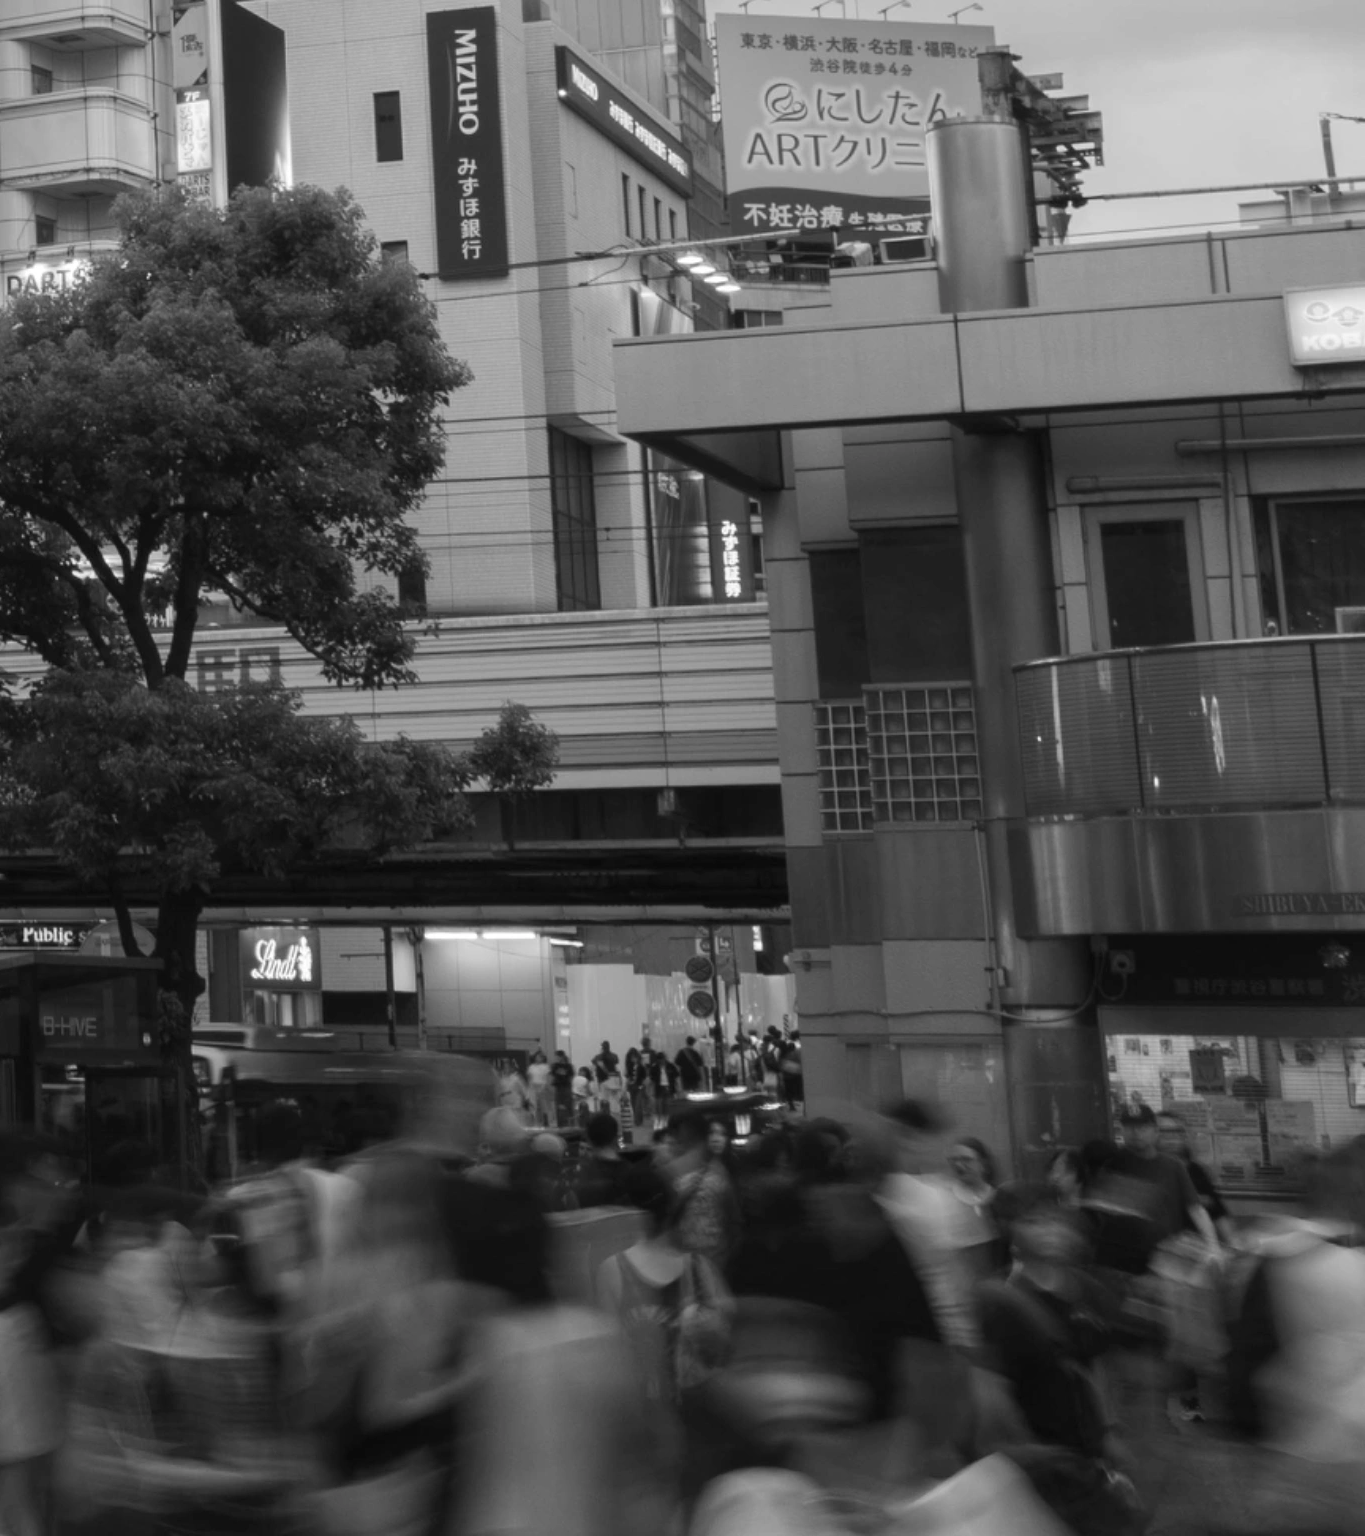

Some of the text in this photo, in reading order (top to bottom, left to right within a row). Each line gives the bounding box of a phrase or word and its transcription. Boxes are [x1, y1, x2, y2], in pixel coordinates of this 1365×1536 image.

[454, 29, 479, 135] MIZUHO
[810, 58, 913, 76] 渋谷院徒歩4分
[747, 132, 925, 169] ARTクリニ
[458, 158, 482, 260] みずほ銀行
[743, 202, 844, 228] 不妊治療
[1302, 333, 1365, 352] KOB
[22, 927, 73, 945] Public
[250, 938, 299, 981] Lindt
